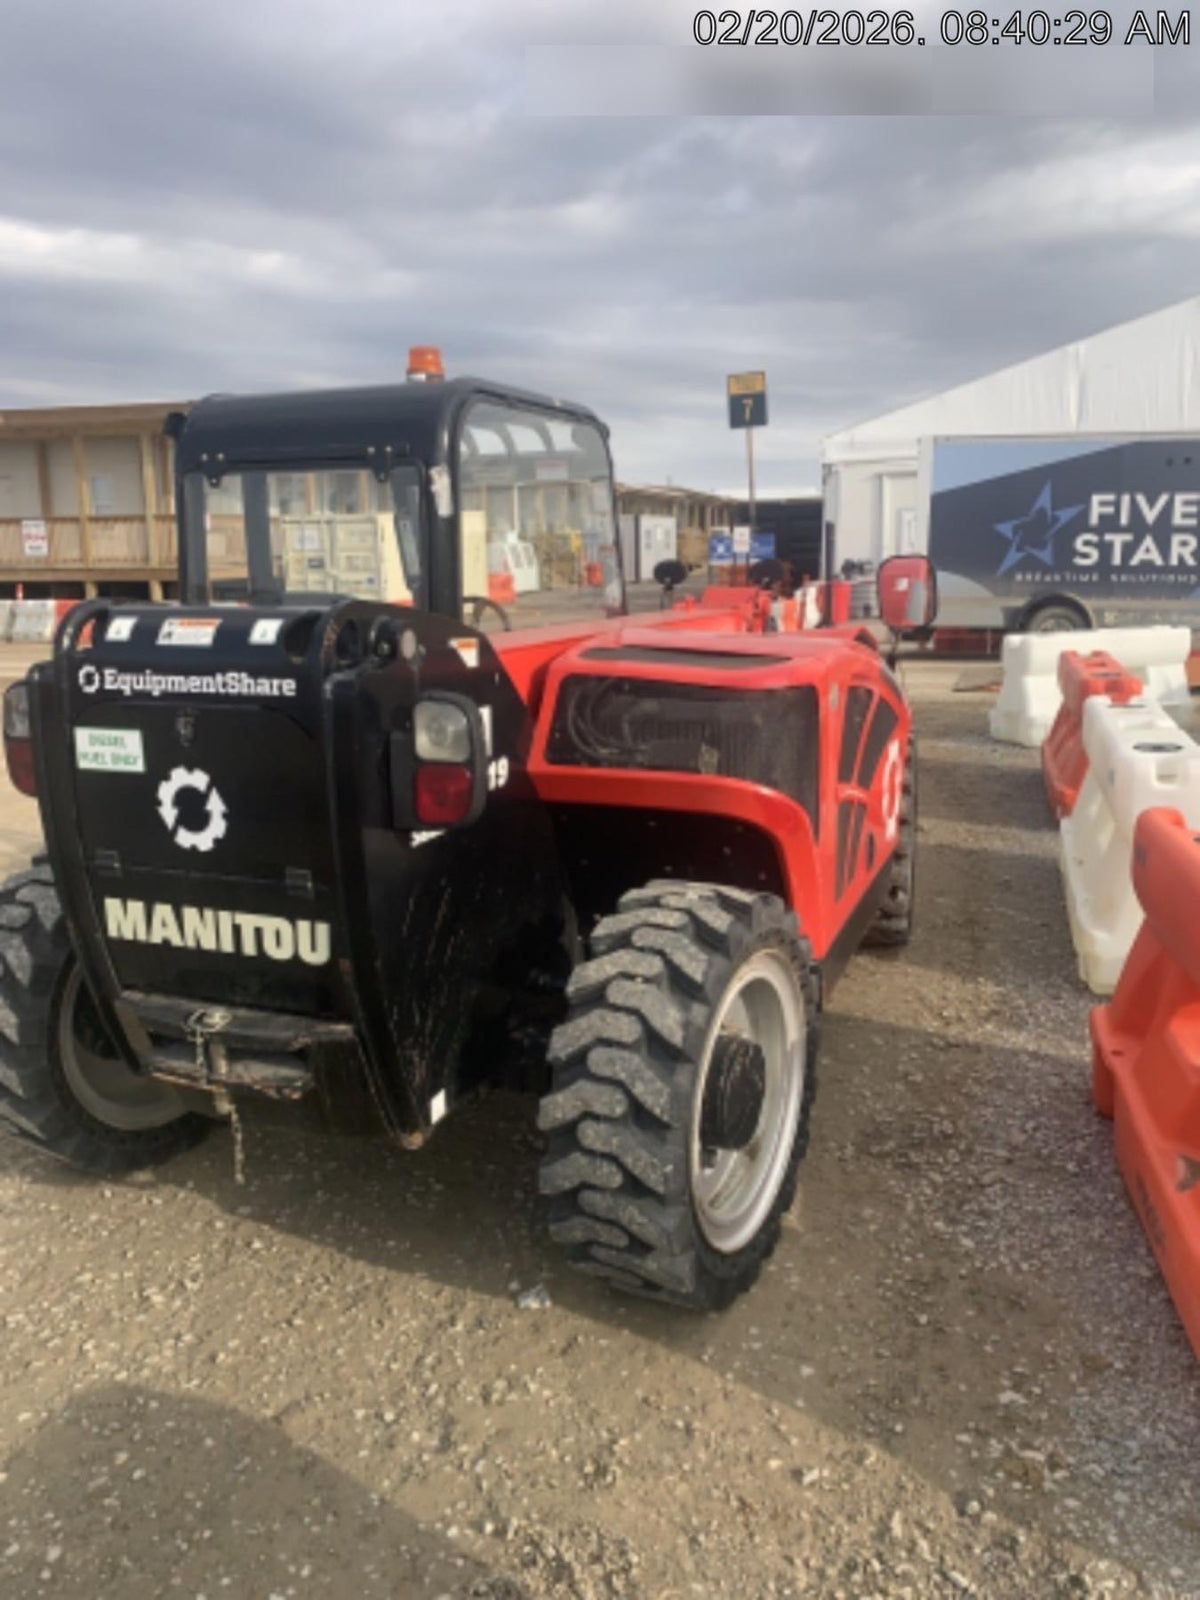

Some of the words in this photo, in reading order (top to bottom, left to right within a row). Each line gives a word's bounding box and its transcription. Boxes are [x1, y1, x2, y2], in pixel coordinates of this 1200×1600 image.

[1088, 492, 1200, 528] FIVE
[1072, 532, 1198, 567] STAR
[103, 667, 297, 697] EquipmentShare
[104, 897, 331, 966] MANITOU
